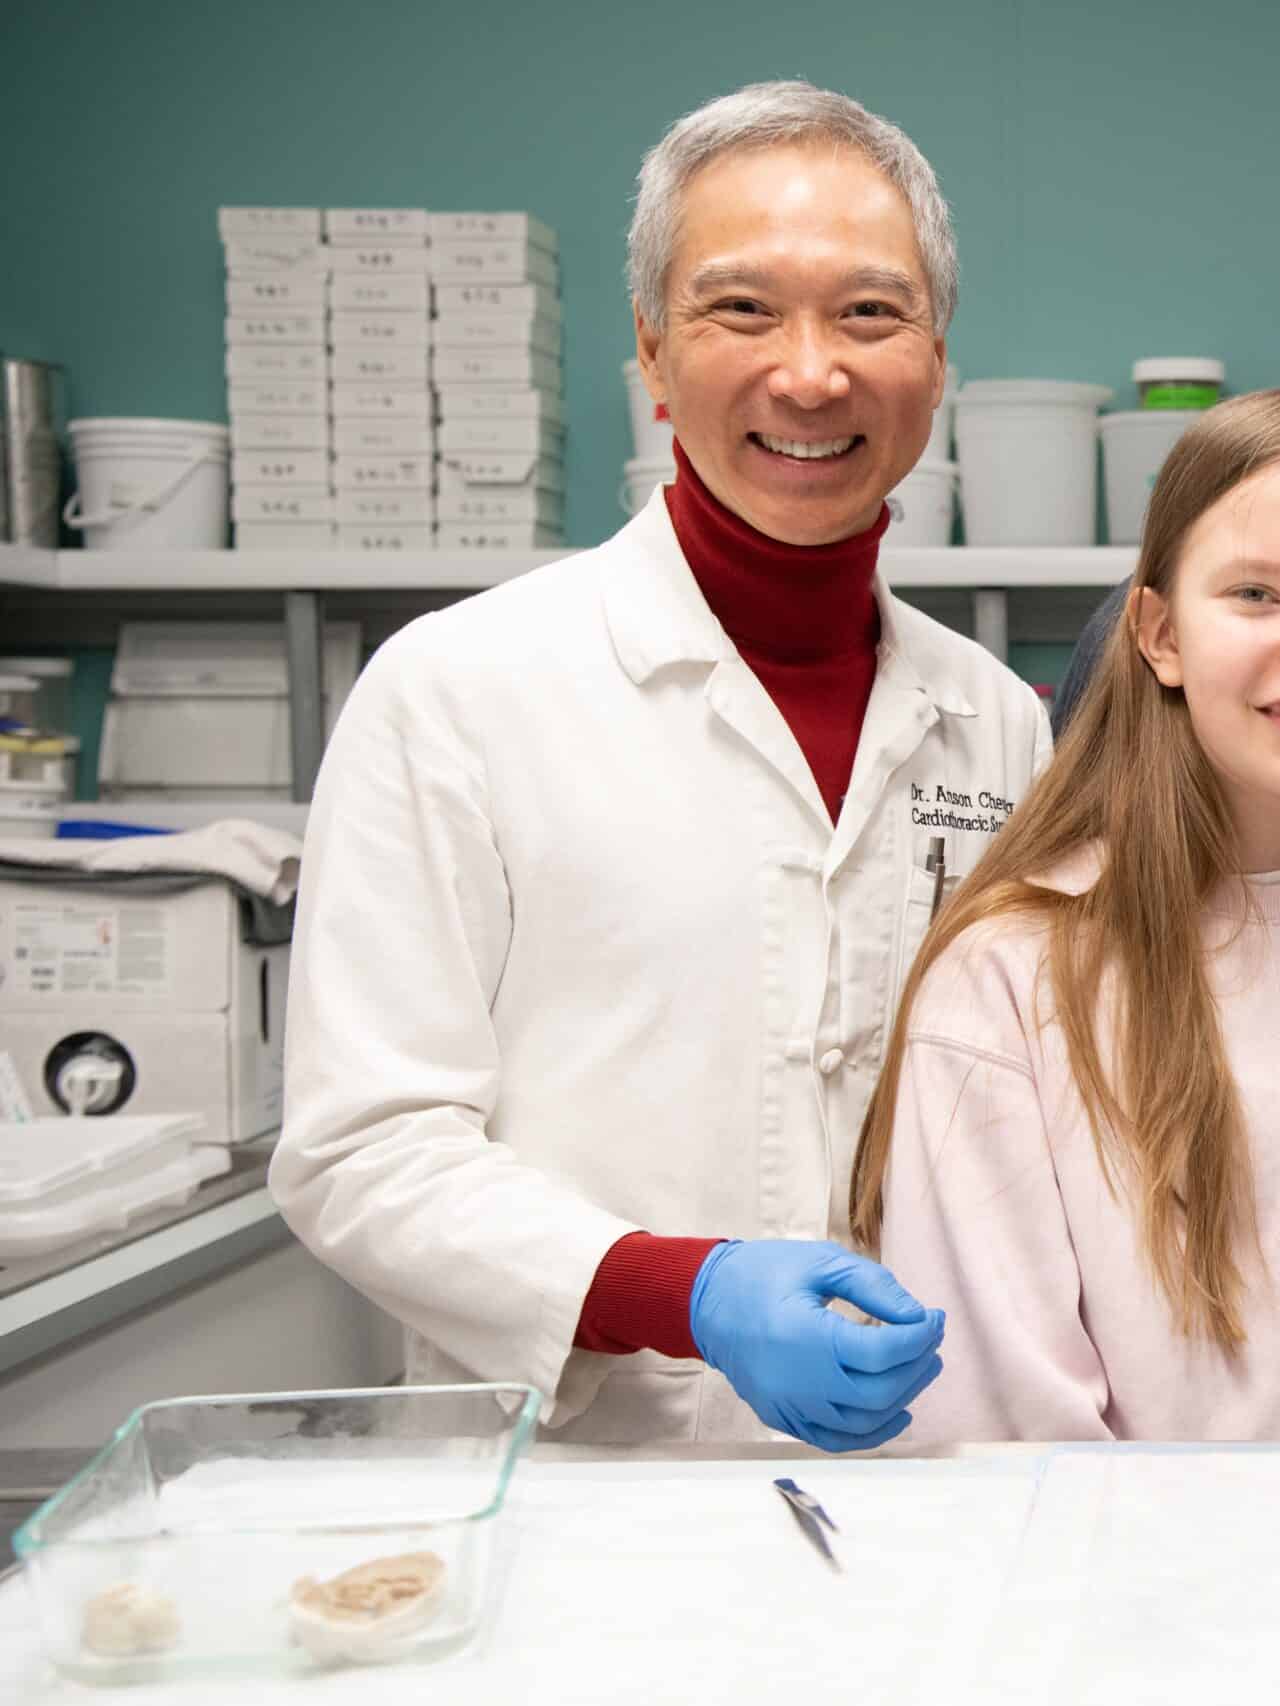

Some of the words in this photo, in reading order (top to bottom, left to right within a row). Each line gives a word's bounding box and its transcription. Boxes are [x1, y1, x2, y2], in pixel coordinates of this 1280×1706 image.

[911, 782, 930, 802] Dr.
[936, 785, 973, 808] Anson
[911, 807, 989, 832] Cardiothoracic
